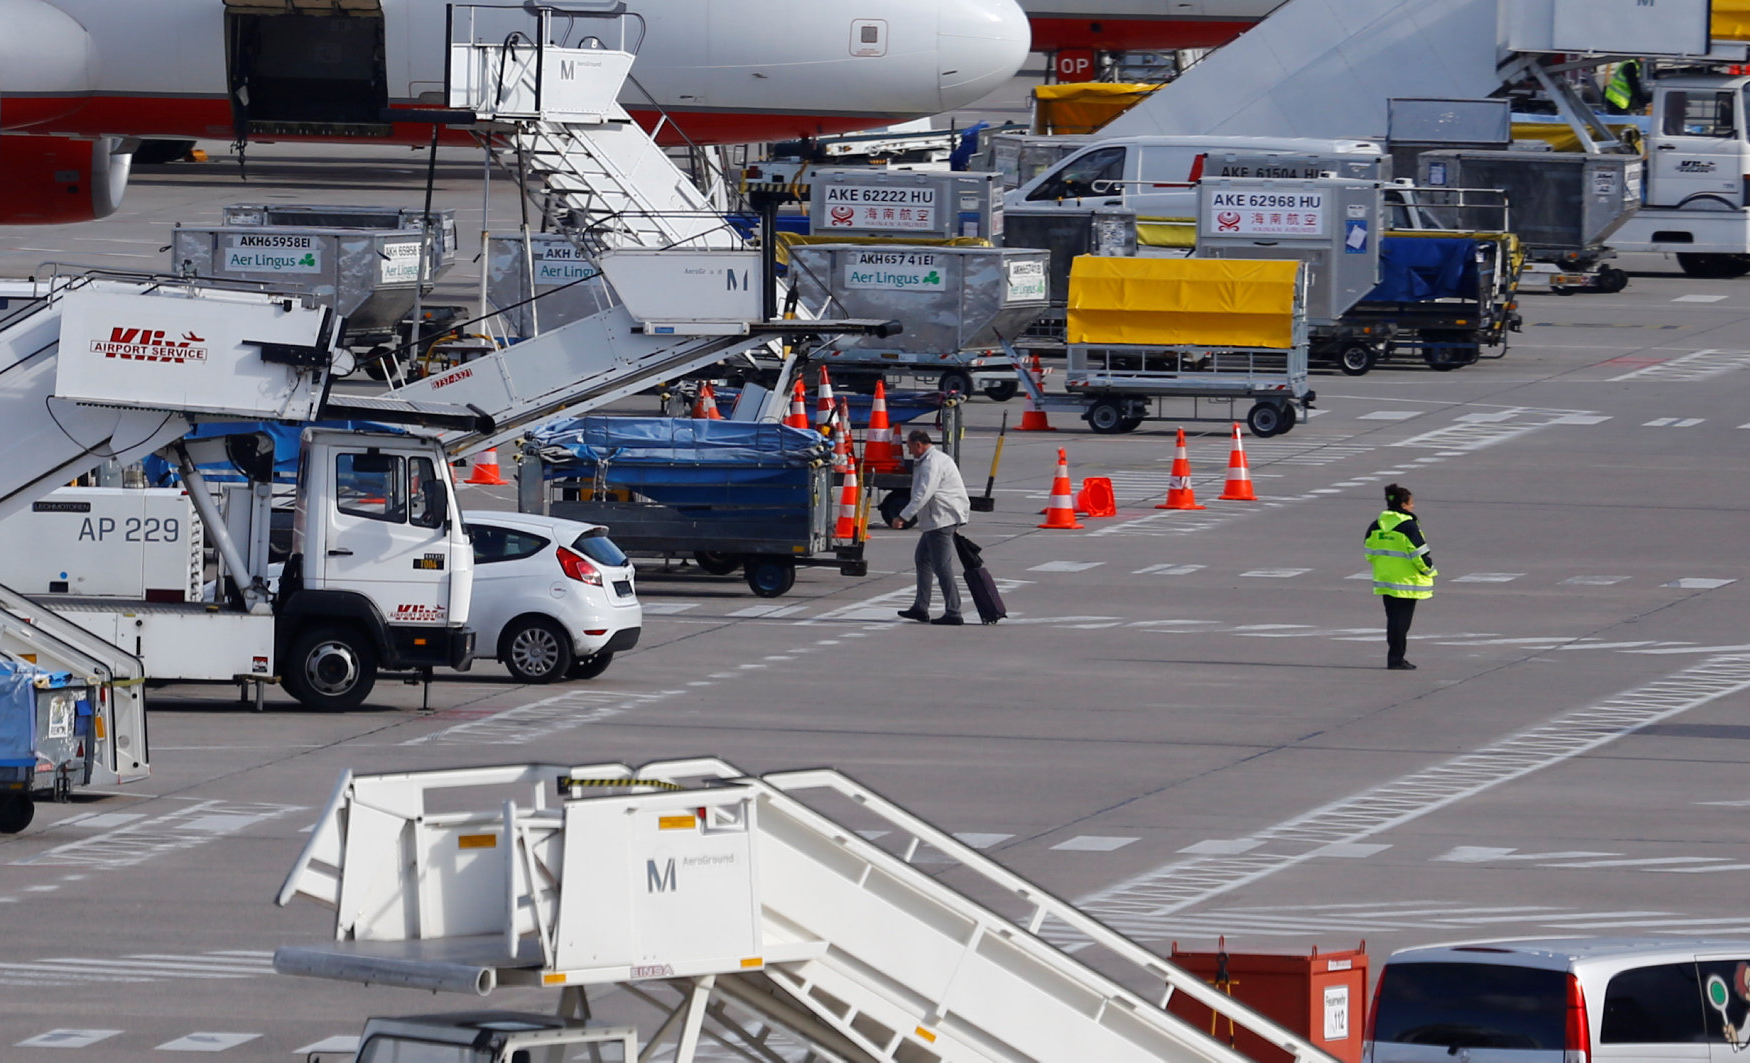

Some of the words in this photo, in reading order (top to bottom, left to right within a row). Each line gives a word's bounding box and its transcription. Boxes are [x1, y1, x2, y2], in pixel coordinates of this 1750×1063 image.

[561, 60, 574, 80] M
[828, 189, 859, 201] AKE
[863, 189, 906, 202] 62222
[911, 191, 933, 203] HU
[1214, 194, 1245, 206] AKE
[1250, 195, 1295, 207] 62968
[1300, 196, 1321, 208] HU
[864, 207, 930, 222] 海南航空
[1251, 212, 1317, 226] 海南航空
[546, 248, 570, 258] AKH
[231, 253, 254, 266] Aer
[255, 254, 296, 269] Lingus
[541, 265, 562, 277] Aer
[850, 271, 872, 283] Aer
[876, 272, 919, 287] Lingus
[95, 342, 148, 355] AIRPORT
[152, 346, 204, 359] SERVICE
[78, 517, 116, 541] AP
[125, 517, 179, 542] 229
[646, 857, 676, 893] M
[683, 854, 734, 866] AeroGround
